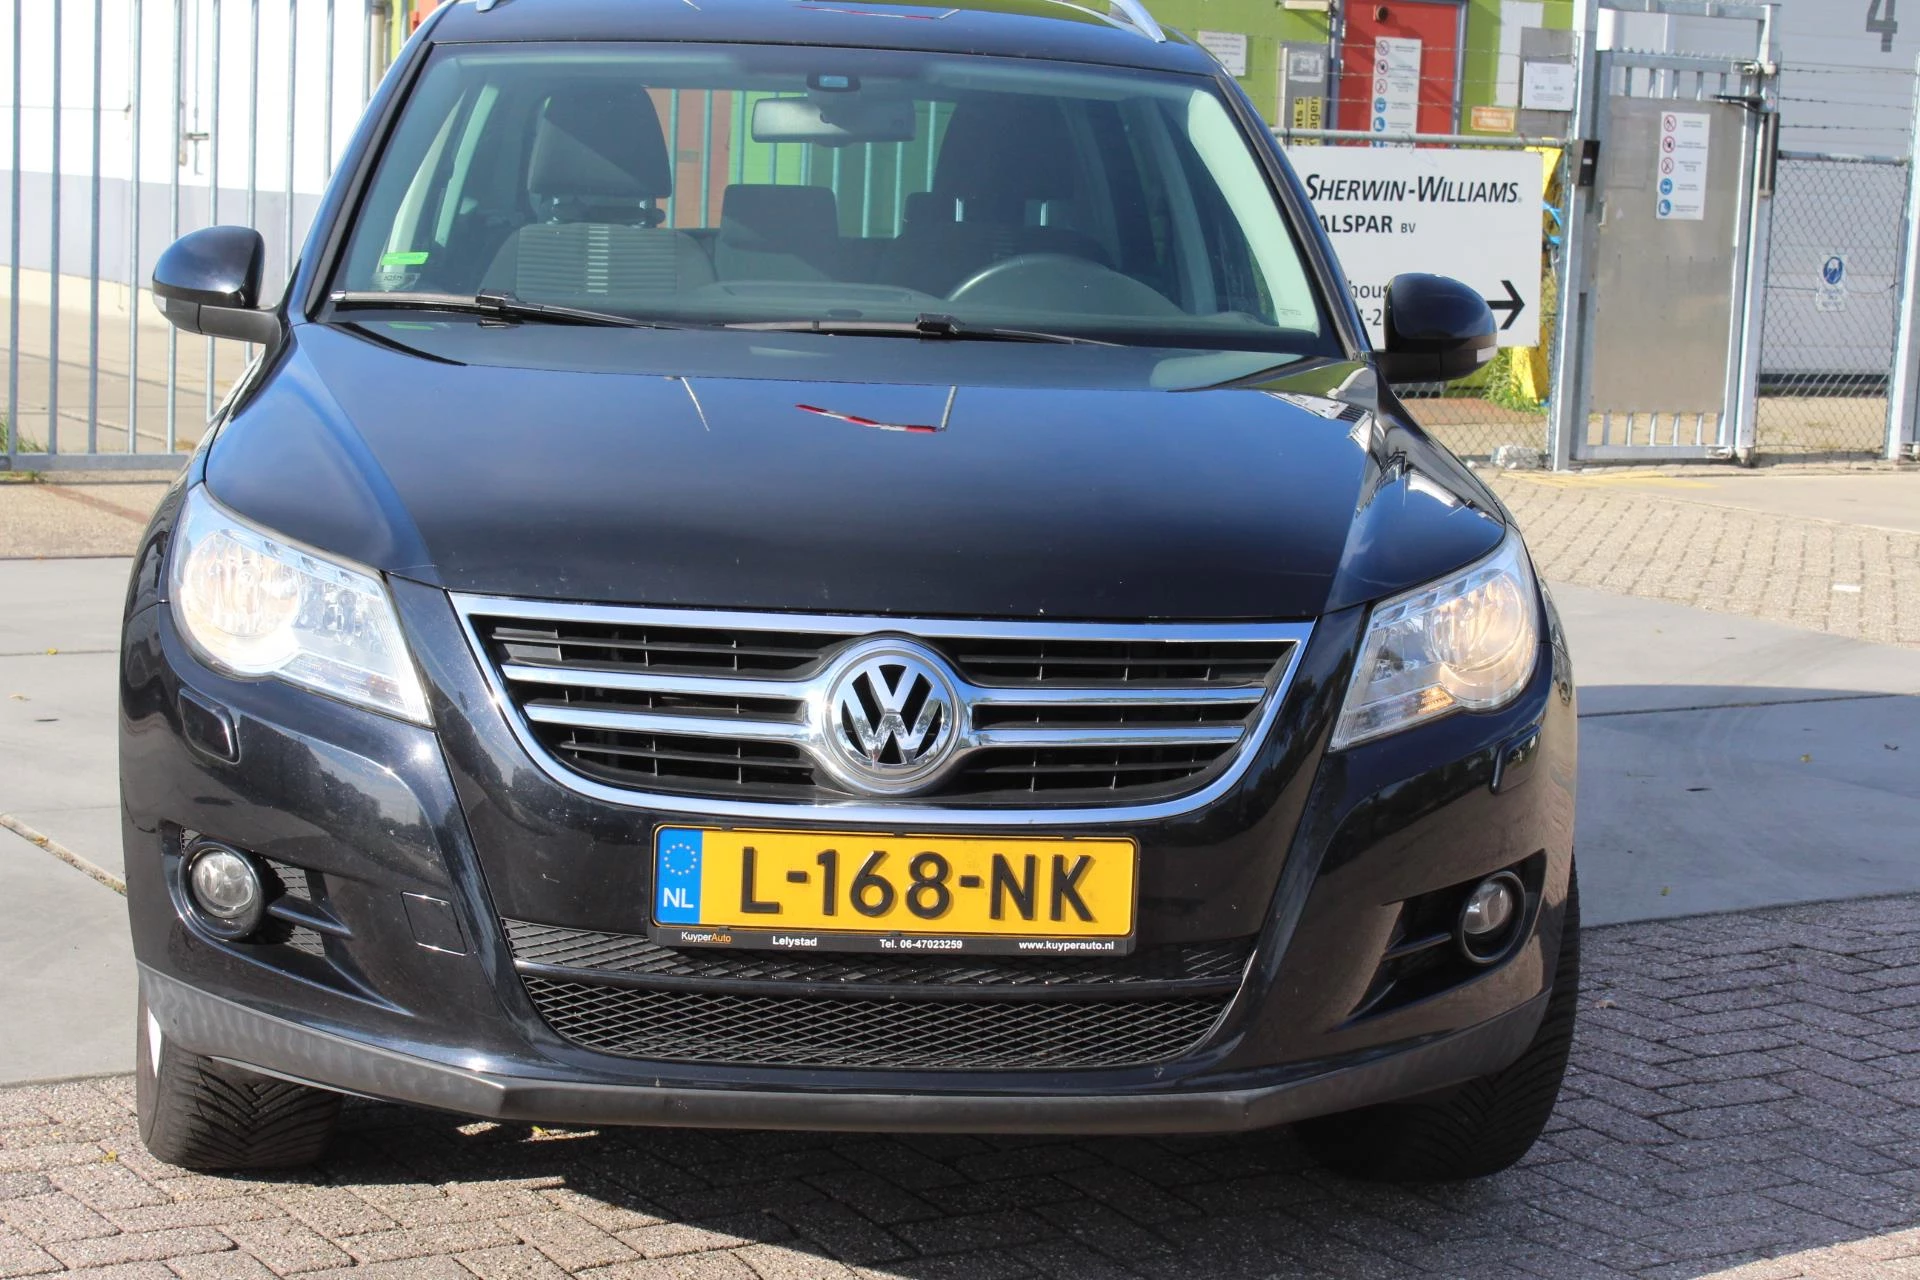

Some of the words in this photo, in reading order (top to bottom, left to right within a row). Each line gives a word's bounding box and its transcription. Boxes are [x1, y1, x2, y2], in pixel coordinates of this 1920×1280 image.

[1400, 222, 1416, 234] BV
[740, 846, 1097, 922] L-168-NK
[663, 887, 695, 909] NL
[681, 931, 732, 944] KuyperAuto
[772, 935, 818, 948] Lelystad
[879, 938, 897, 949] Tel.
[900, 939, 963, 950] 06-47023259
[1018, 939, 1115, 952] www.kuyperauto.nl
